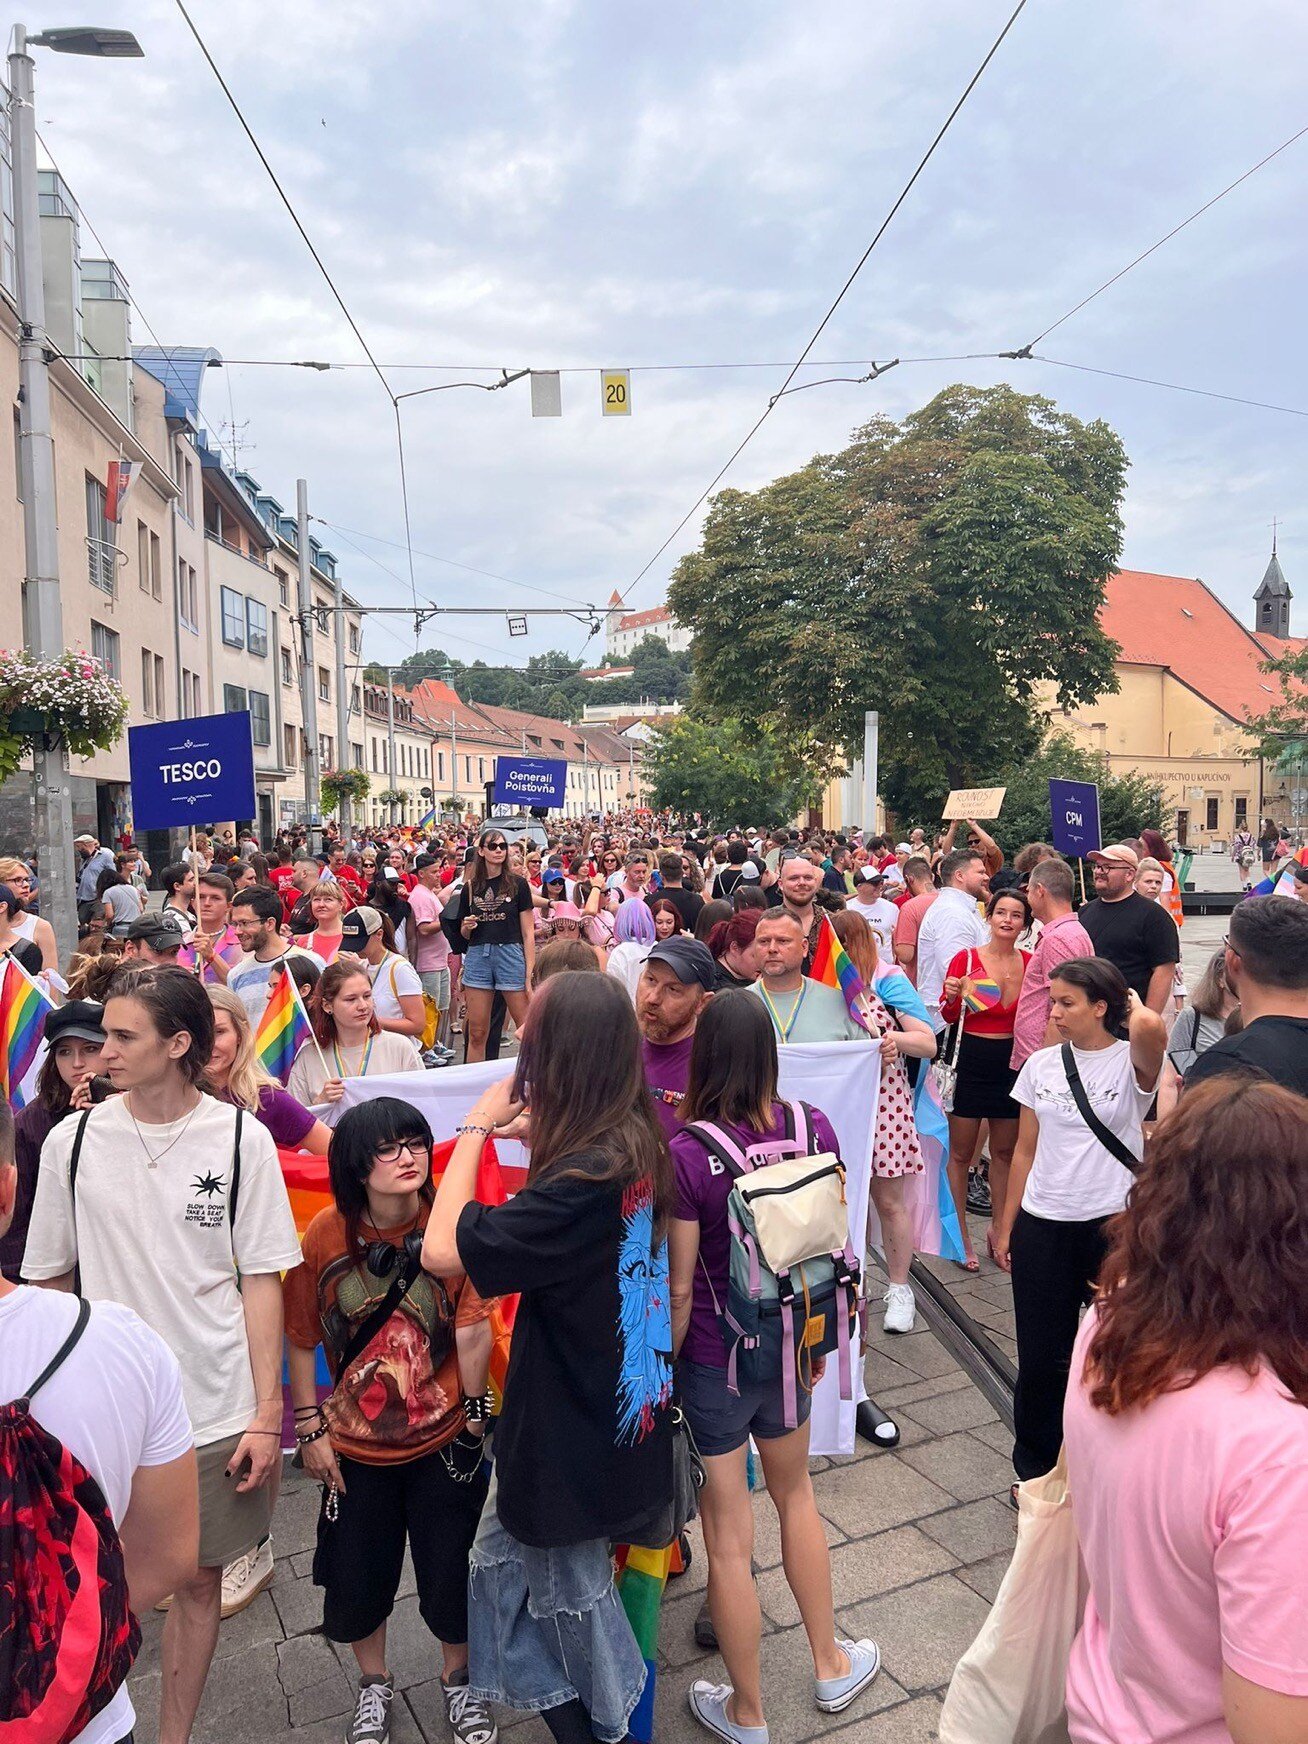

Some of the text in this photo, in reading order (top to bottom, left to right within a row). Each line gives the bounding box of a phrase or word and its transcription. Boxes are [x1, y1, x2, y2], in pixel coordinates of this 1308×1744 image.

[606, 384, 626, 403] 20
[159, 759, 221, 784] TESCO
[509, 771, 553, 783] Generali
[505, 781, 556, 794] Poisťovňa
[1065, 810, 1083, 827] CPM
[478, 912, 507, 922] didas
